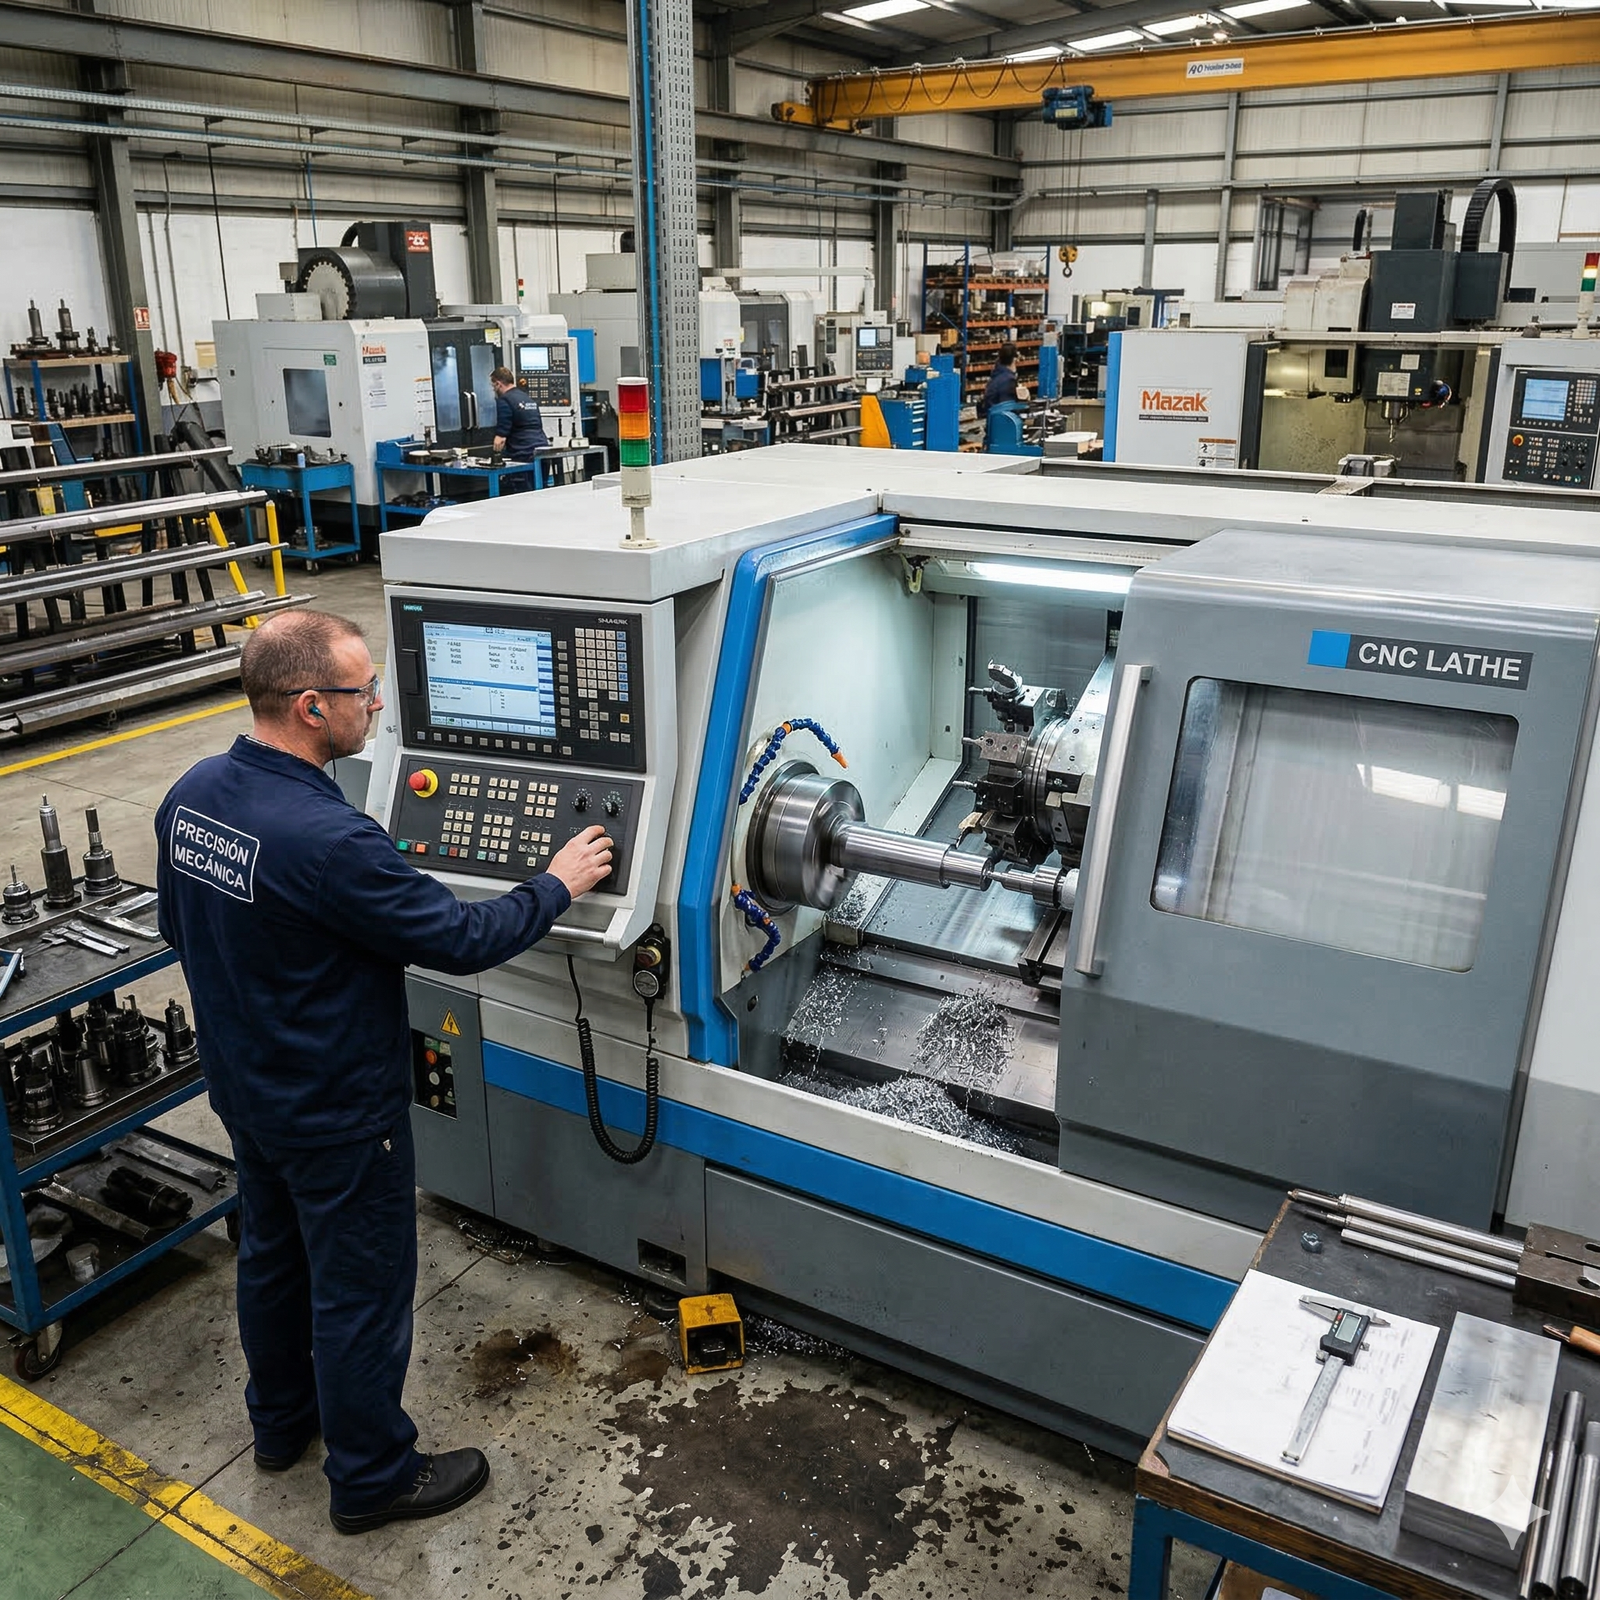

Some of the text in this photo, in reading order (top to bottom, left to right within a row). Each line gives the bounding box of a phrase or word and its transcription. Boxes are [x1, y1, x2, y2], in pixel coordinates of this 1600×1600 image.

[1142, 391, 1207, 412] Mazak
[1358, 642, 1522, 680] CNC LATHE
[176, 819, 249, 866] PRECISIÓN
[174, 844, 246, 891] MECÁNICA
